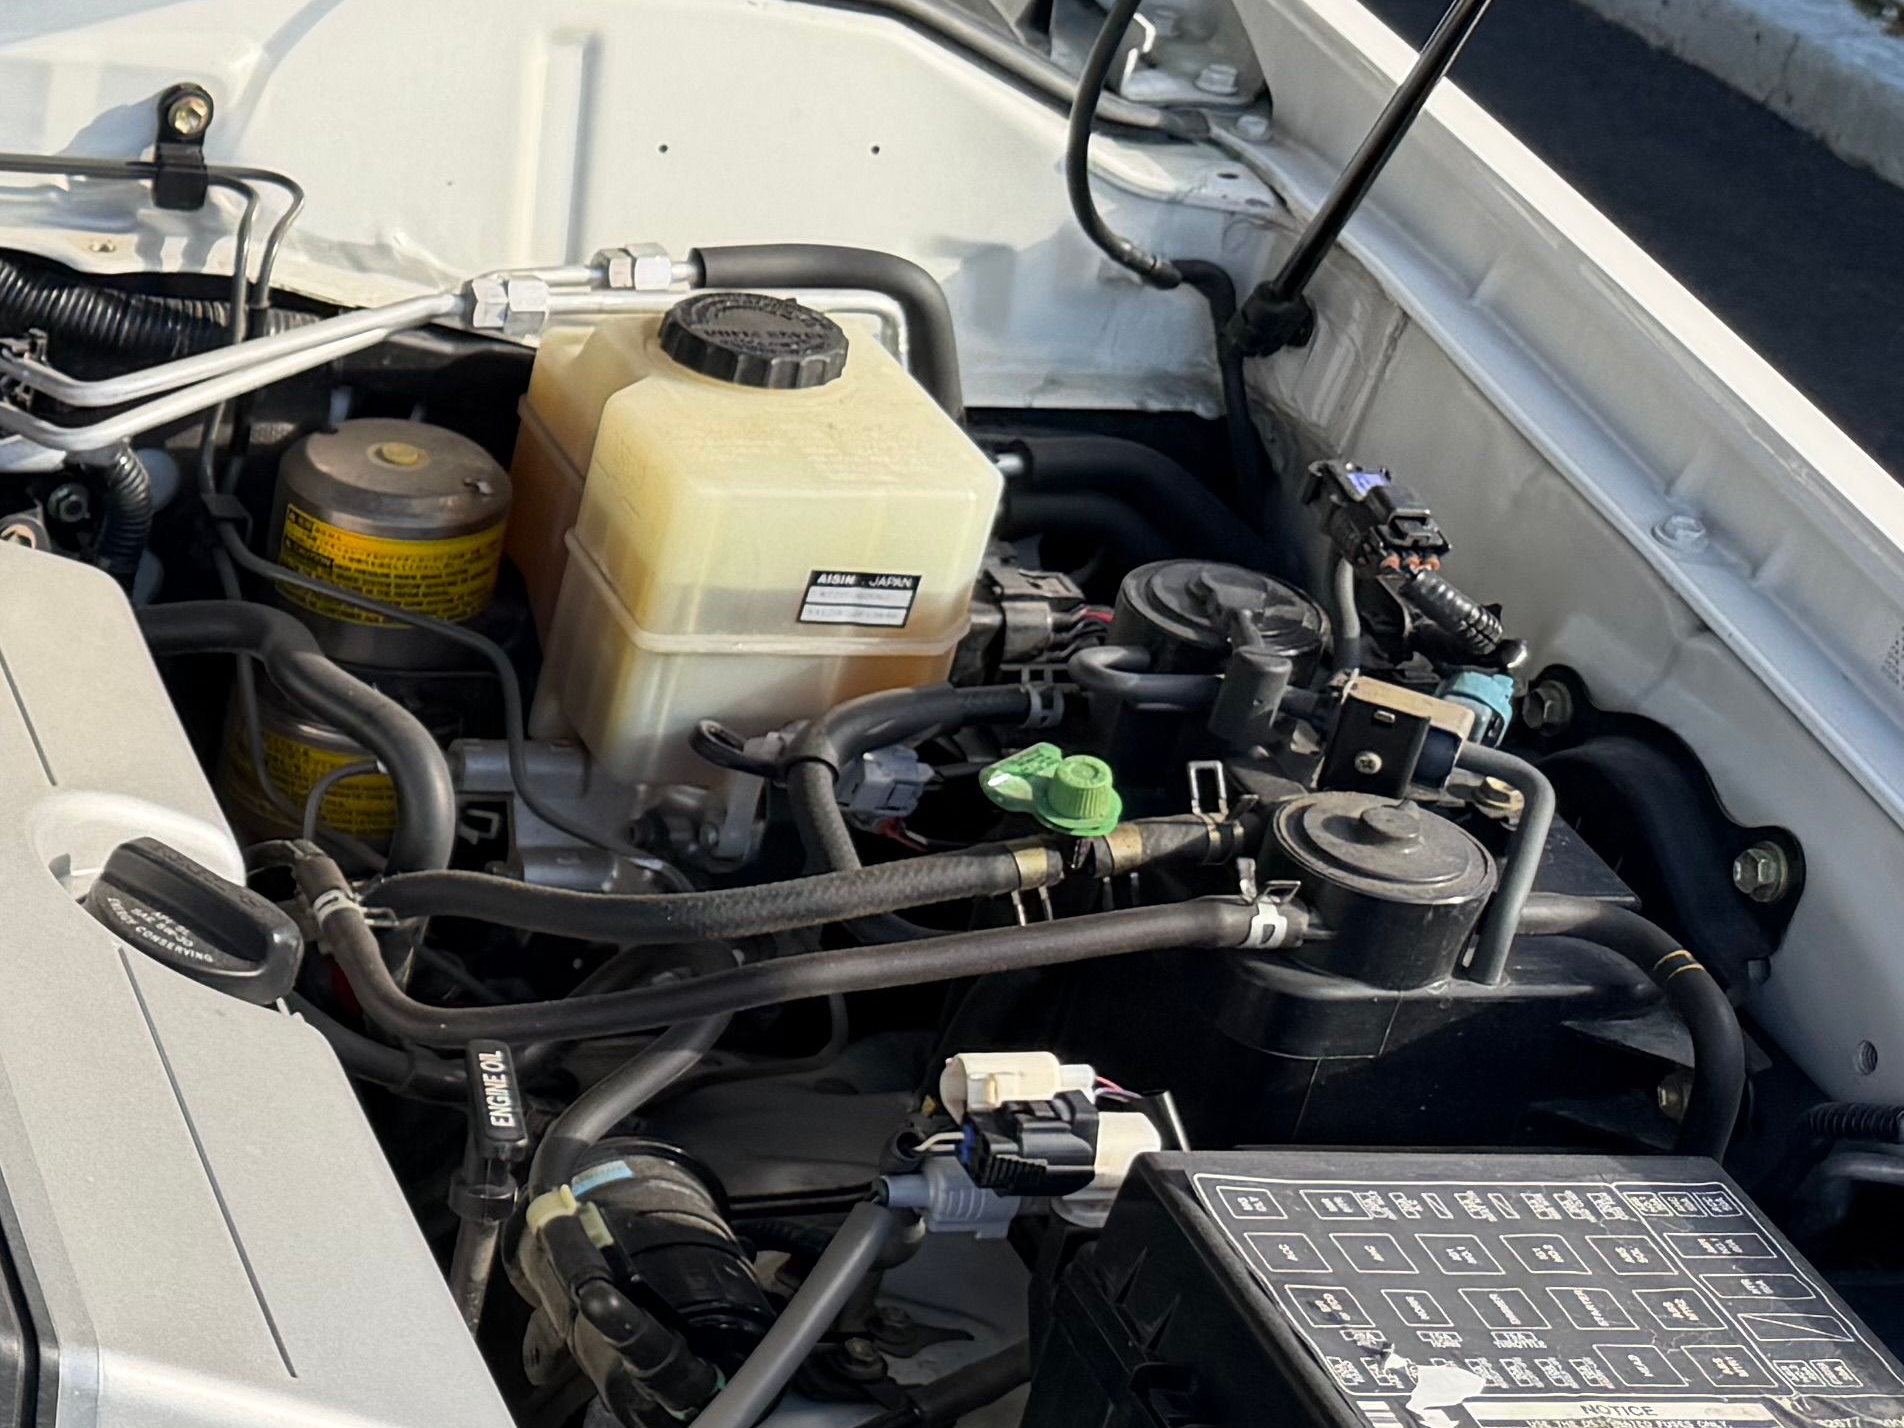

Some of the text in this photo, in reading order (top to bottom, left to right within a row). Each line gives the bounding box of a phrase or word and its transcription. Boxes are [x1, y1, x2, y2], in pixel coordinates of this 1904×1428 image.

[817, 573, 913, 587] AISIN JAPAN
[135, 925, 215, 963] CONSERVING
[479, 1049, 518, 1128] ENGINE OIL
[1571, 1288, 1612, 1326] STARTER
[1624, 1353, 1655, 1377] HEAD
[1581, 1404, 1658, 1417] NOTICE
[1655, 1420, 1691, 1428] FUSES
